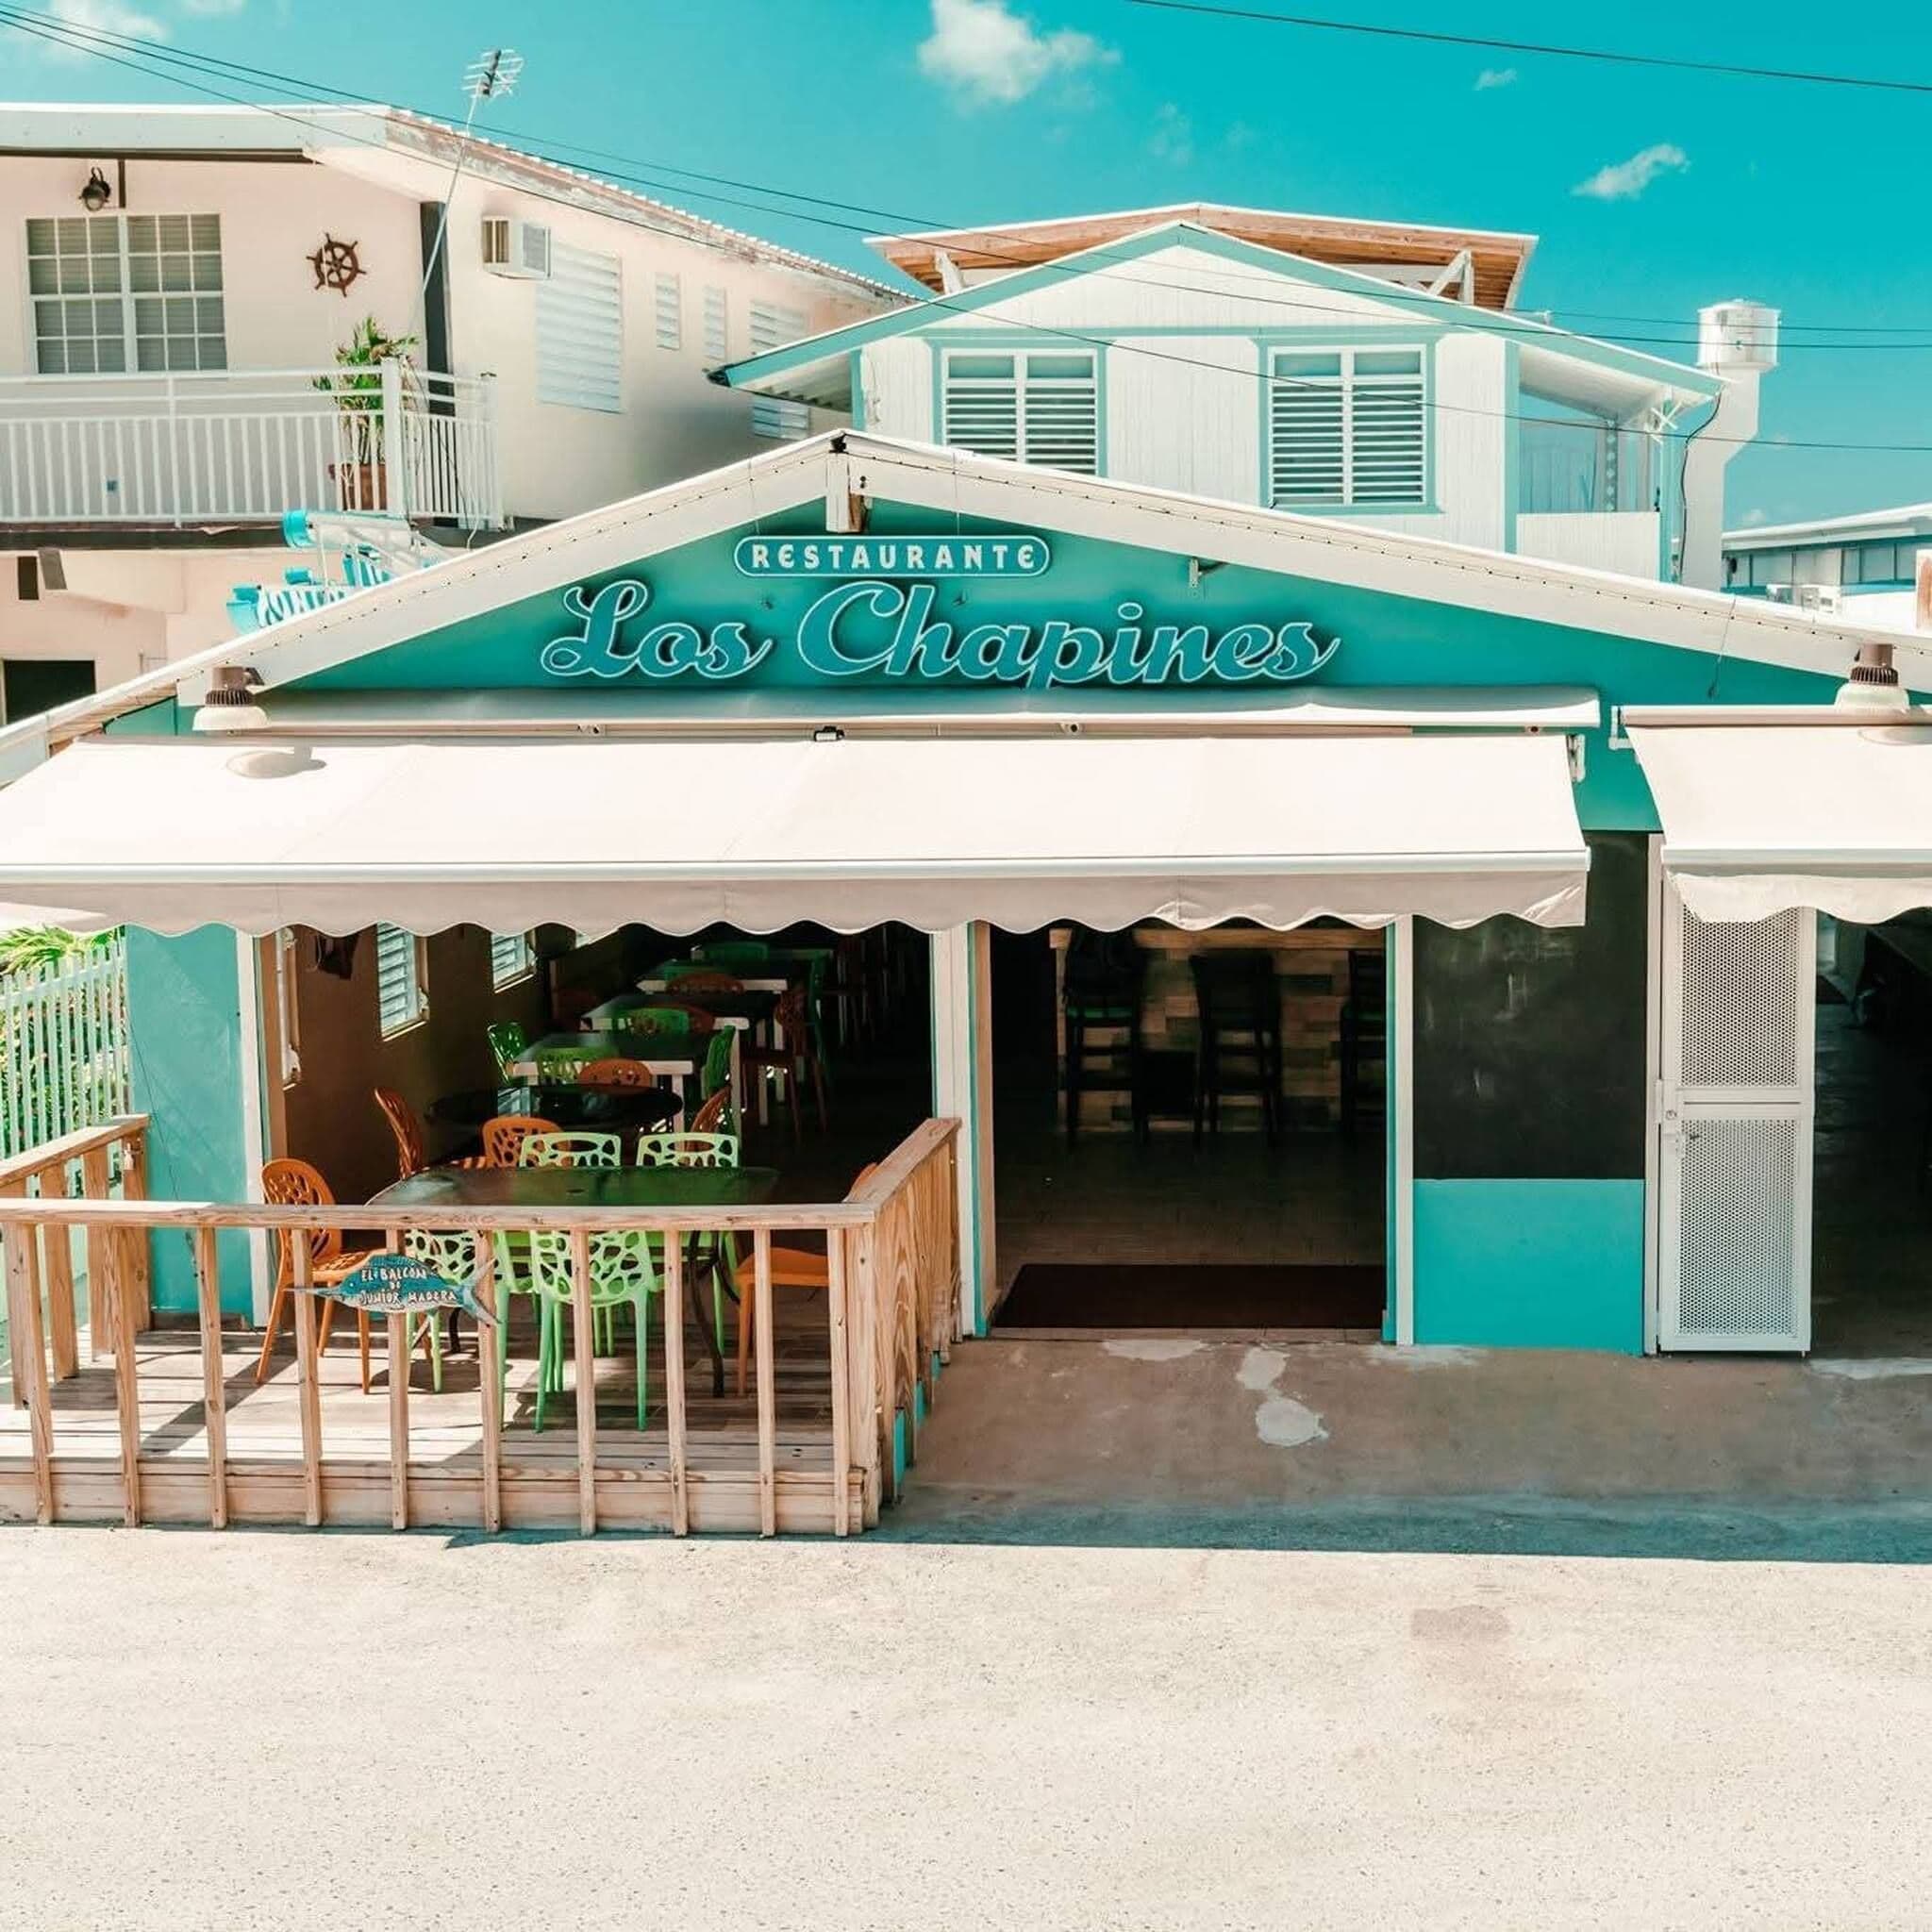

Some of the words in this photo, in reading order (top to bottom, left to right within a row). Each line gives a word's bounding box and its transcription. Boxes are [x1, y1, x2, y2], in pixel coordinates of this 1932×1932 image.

[752, 542, 1036, 571] RESTAURANTE
[541, 579, 771, 679] Los
[796, 579, 1341, 689] Chapines
[361, 1268, 374, 1281] EL
[407, 1291, 457, 1304] MADERA
